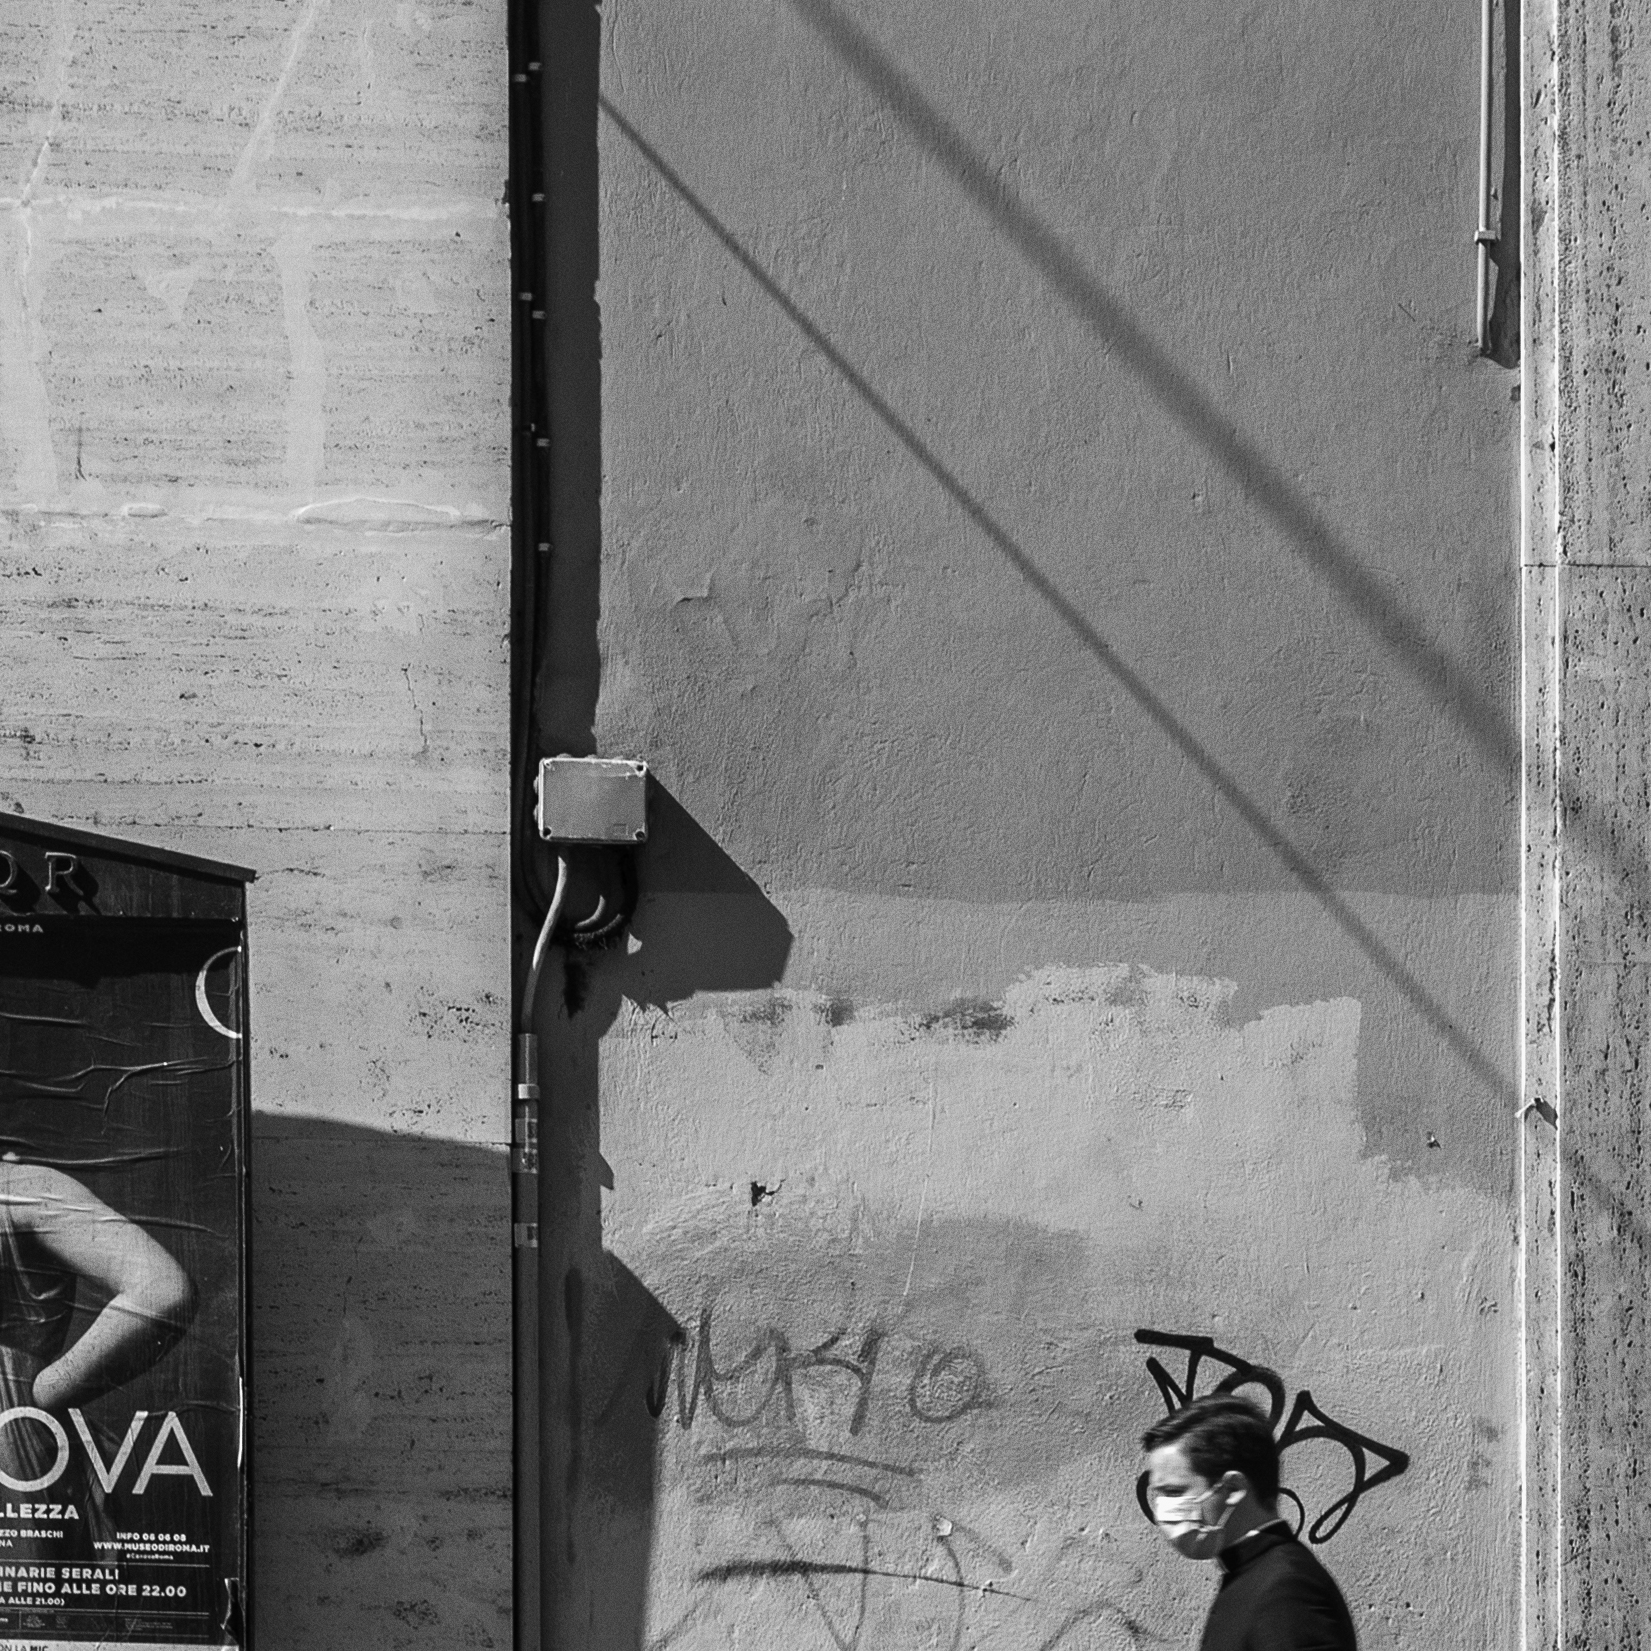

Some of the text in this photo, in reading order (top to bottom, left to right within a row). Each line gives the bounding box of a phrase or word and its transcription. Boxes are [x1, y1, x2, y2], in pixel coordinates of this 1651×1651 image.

[20, 1529, 64, 1539] BRASCHI
[116, 1531, 140, 1541] INFO
[158, 1533, 171, 1542] 06
[93, 1541, 210, 1553] WWW.MUSEODIROMA.IT
[61, 1567, 119, 1580] SERALI
[17, 1581, 56, 1594] FINO
[60, 1582, 101, 1595] ALLE
[105, 1583, 138, 1596] ORE
[141, 1584, 187, 1598] 22.00
[8, 1596, 33, 1605] ALLE
[35, 1597, 65, 1606] 21.00)
